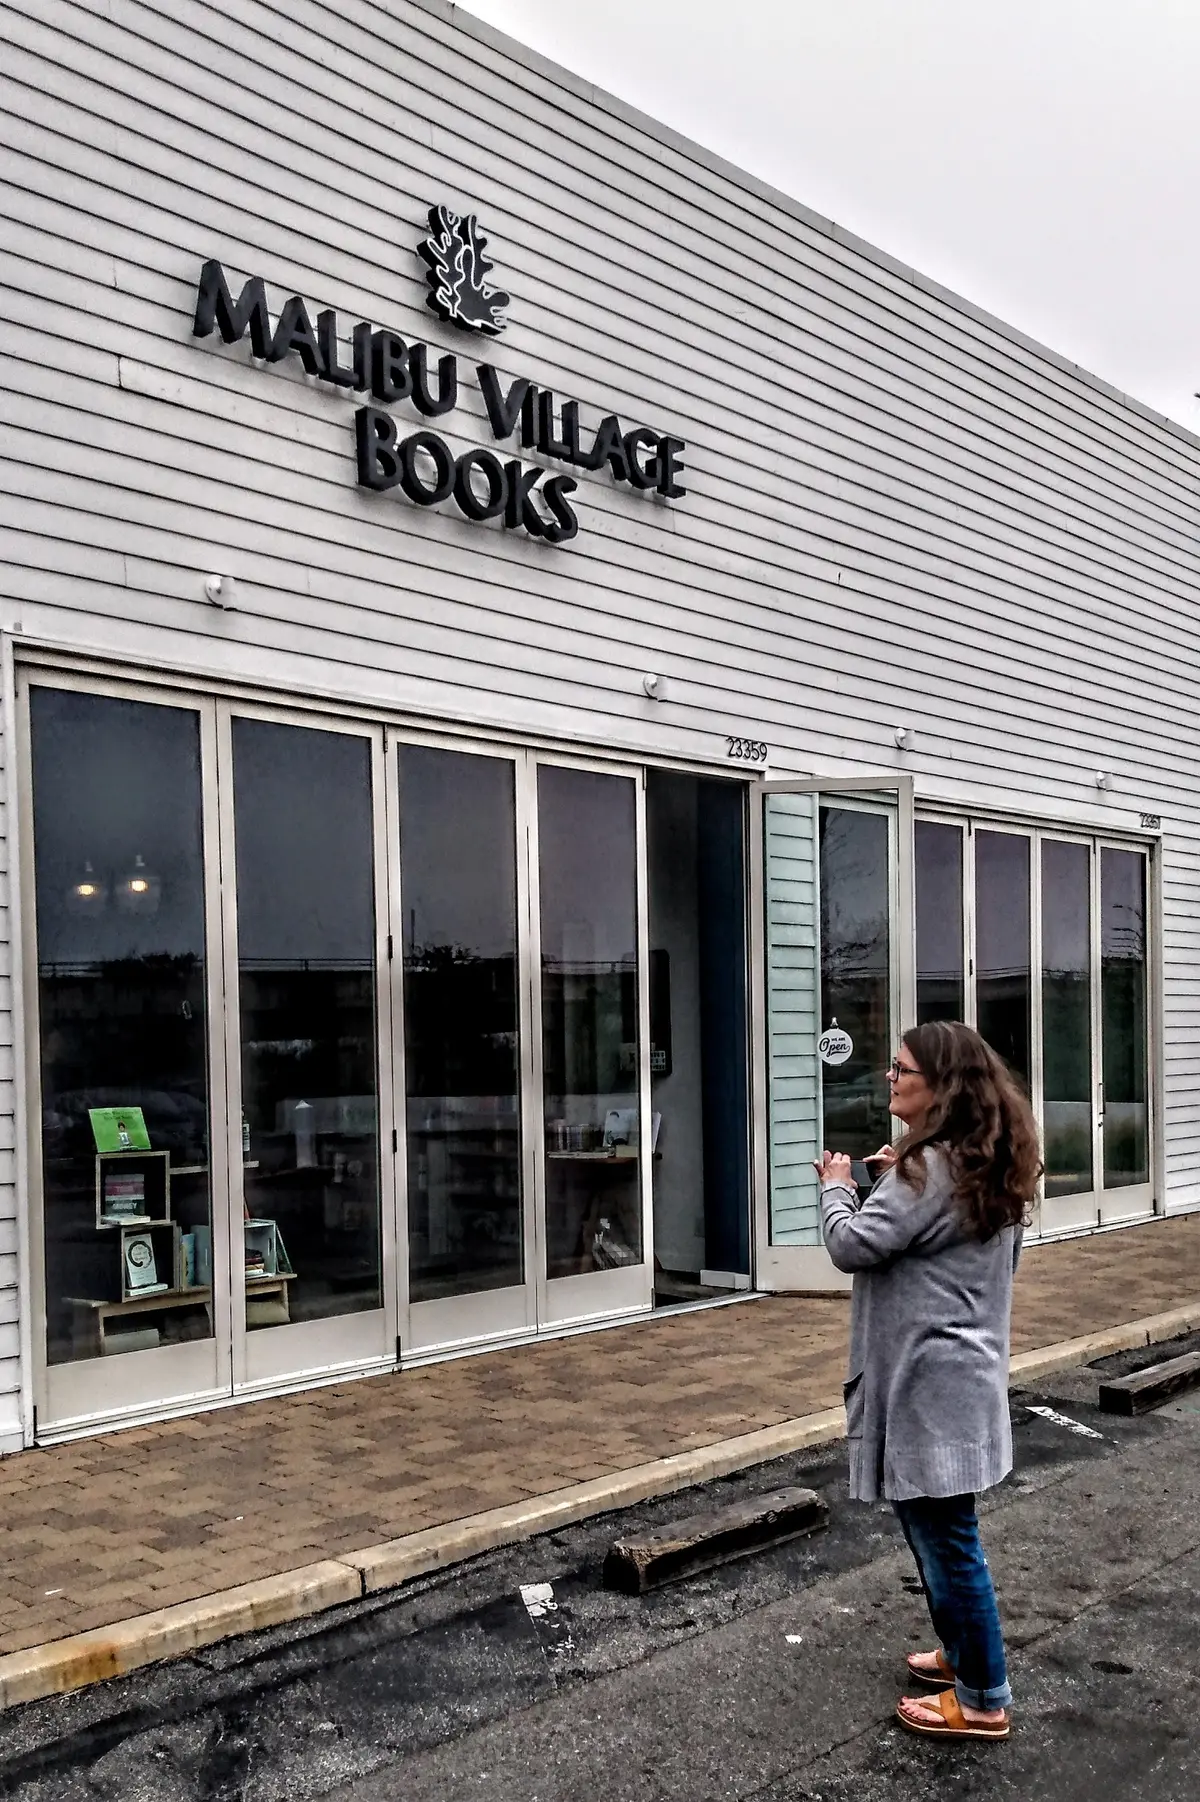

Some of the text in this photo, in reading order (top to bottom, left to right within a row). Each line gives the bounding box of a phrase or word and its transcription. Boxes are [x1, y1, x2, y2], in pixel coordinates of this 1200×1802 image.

[193, 259, 686, 498] MALIBU VILLAGE
[355, 406, 578, 542] BOOKS
[726, 736, 768, 762] 23359
[819, 1037, 850, 1057] Open
